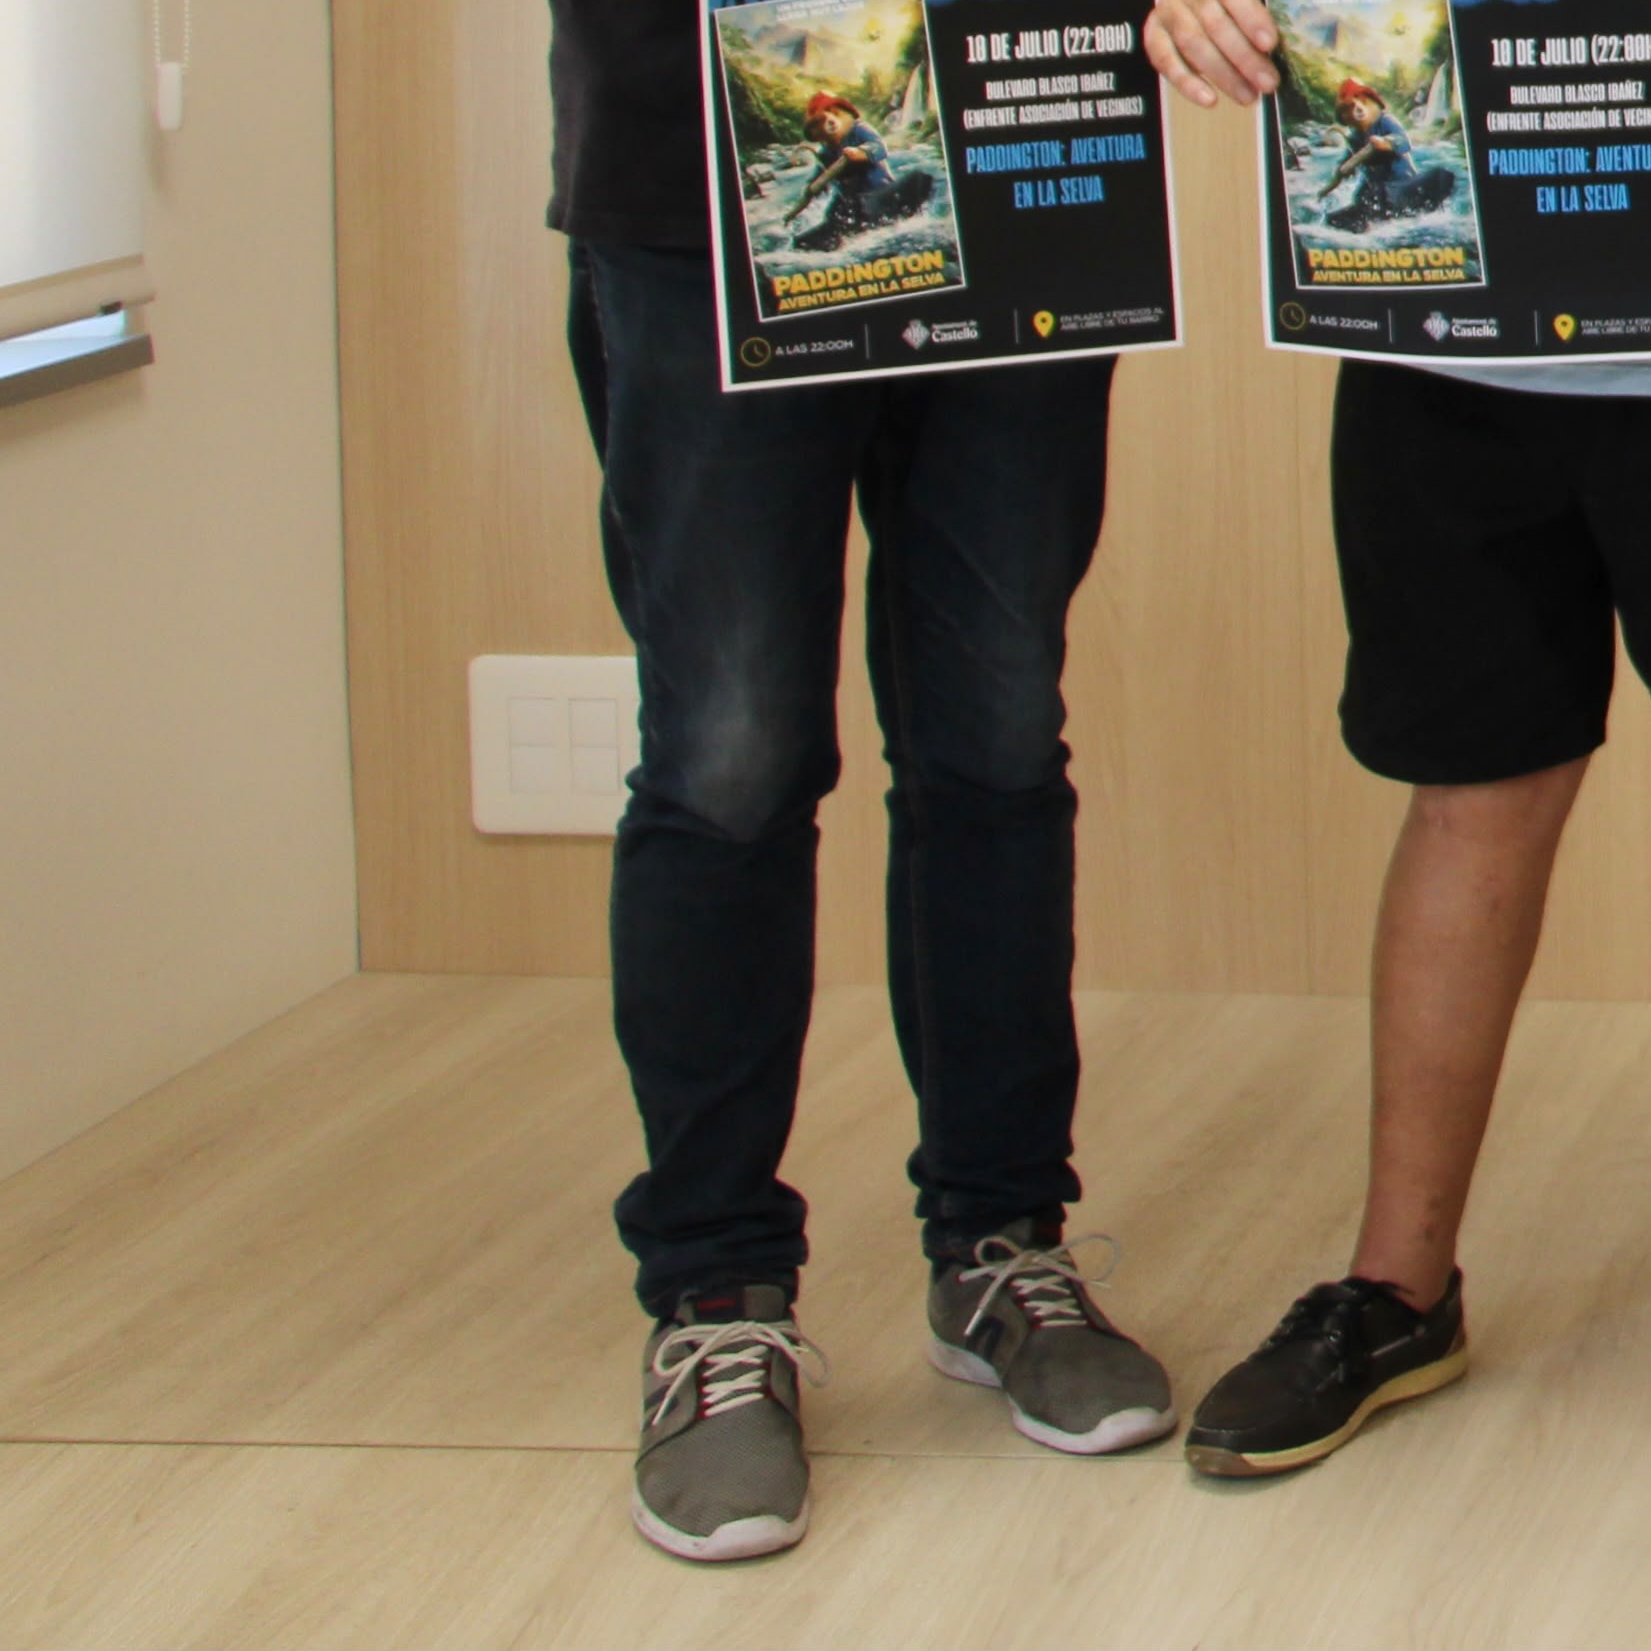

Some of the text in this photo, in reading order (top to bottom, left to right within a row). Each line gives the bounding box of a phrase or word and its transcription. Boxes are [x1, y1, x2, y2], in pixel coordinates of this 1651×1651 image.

[991, 33, 1010, 61] DE
[1015, 30, 1059, 58] JULIO
[1516, 38, 1536, 65] DE
[1540, 36, 1585, 64] JULIO
[1039, 75, 1077, 96] BLASCO
[1565, 84, 1605, 103] BLASCO
[1081, 100, 1094, 119] DE
[1608, 108, 1620, 127] DE
[966, 134, 1145, 173] PADDINGTON: AVENTURA
[1489, 148, 1591, 175] PADDINGTON:
[1014, 176, 1103, 208] EN LA SELVA
[1536, 183, 1628, 213] EN LA SELVA
